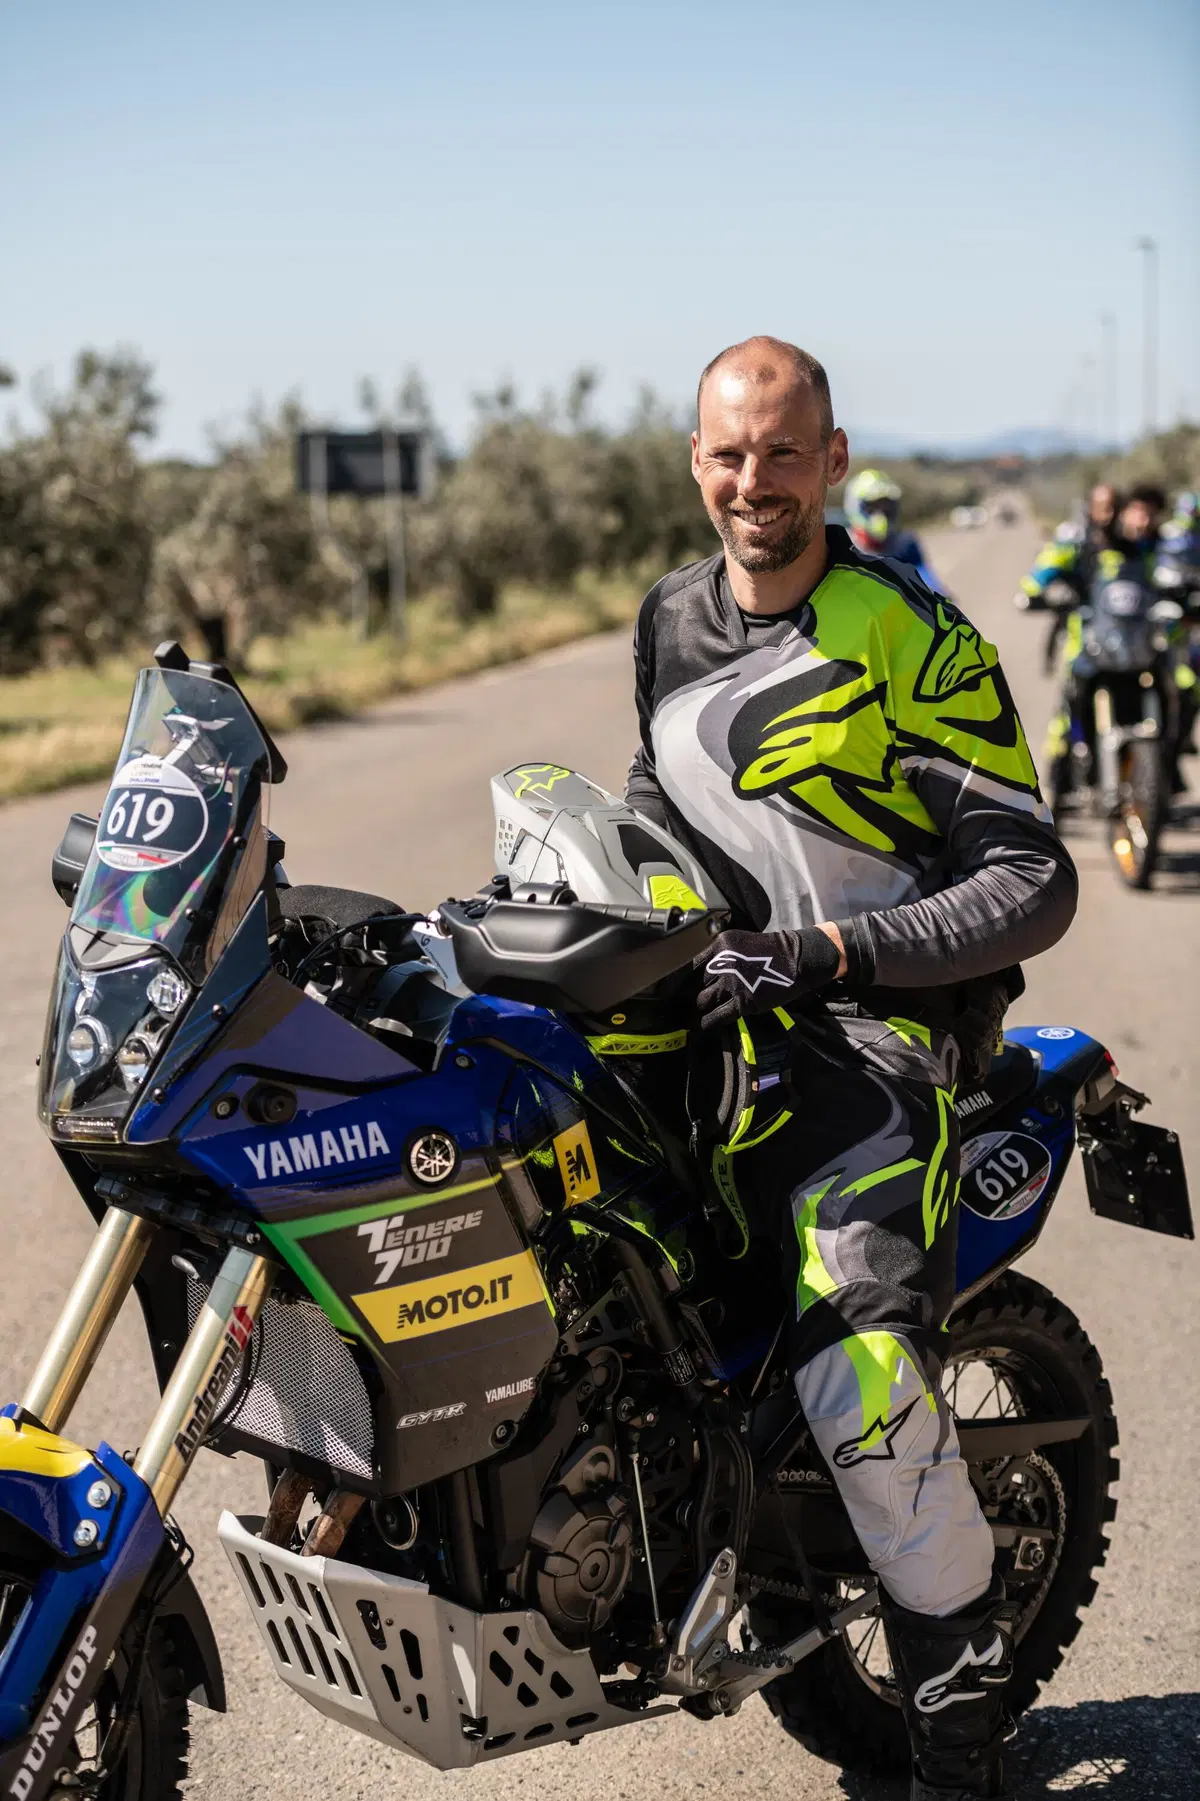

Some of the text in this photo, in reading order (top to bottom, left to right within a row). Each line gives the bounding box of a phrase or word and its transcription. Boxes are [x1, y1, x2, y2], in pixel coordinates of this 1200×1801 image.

[107, 791, 175, 843] 619
[954, 1090, 994, 1119] AMAHA
[243, 1121, 391, 1180] YAMAHA
[975, 1148, 1029, 1201] 619
[374, 1235, 453, 1285] 700
[397, 1274, 513, 1329] MOTO.IT
[174, 1332, 241, 1464] Andreani
[396, 1401, 467, 1429] GYTR
[485, 1377, 535, 1404] YAMALUBE
[9, 1624, 97, 1801] DUNLOP
